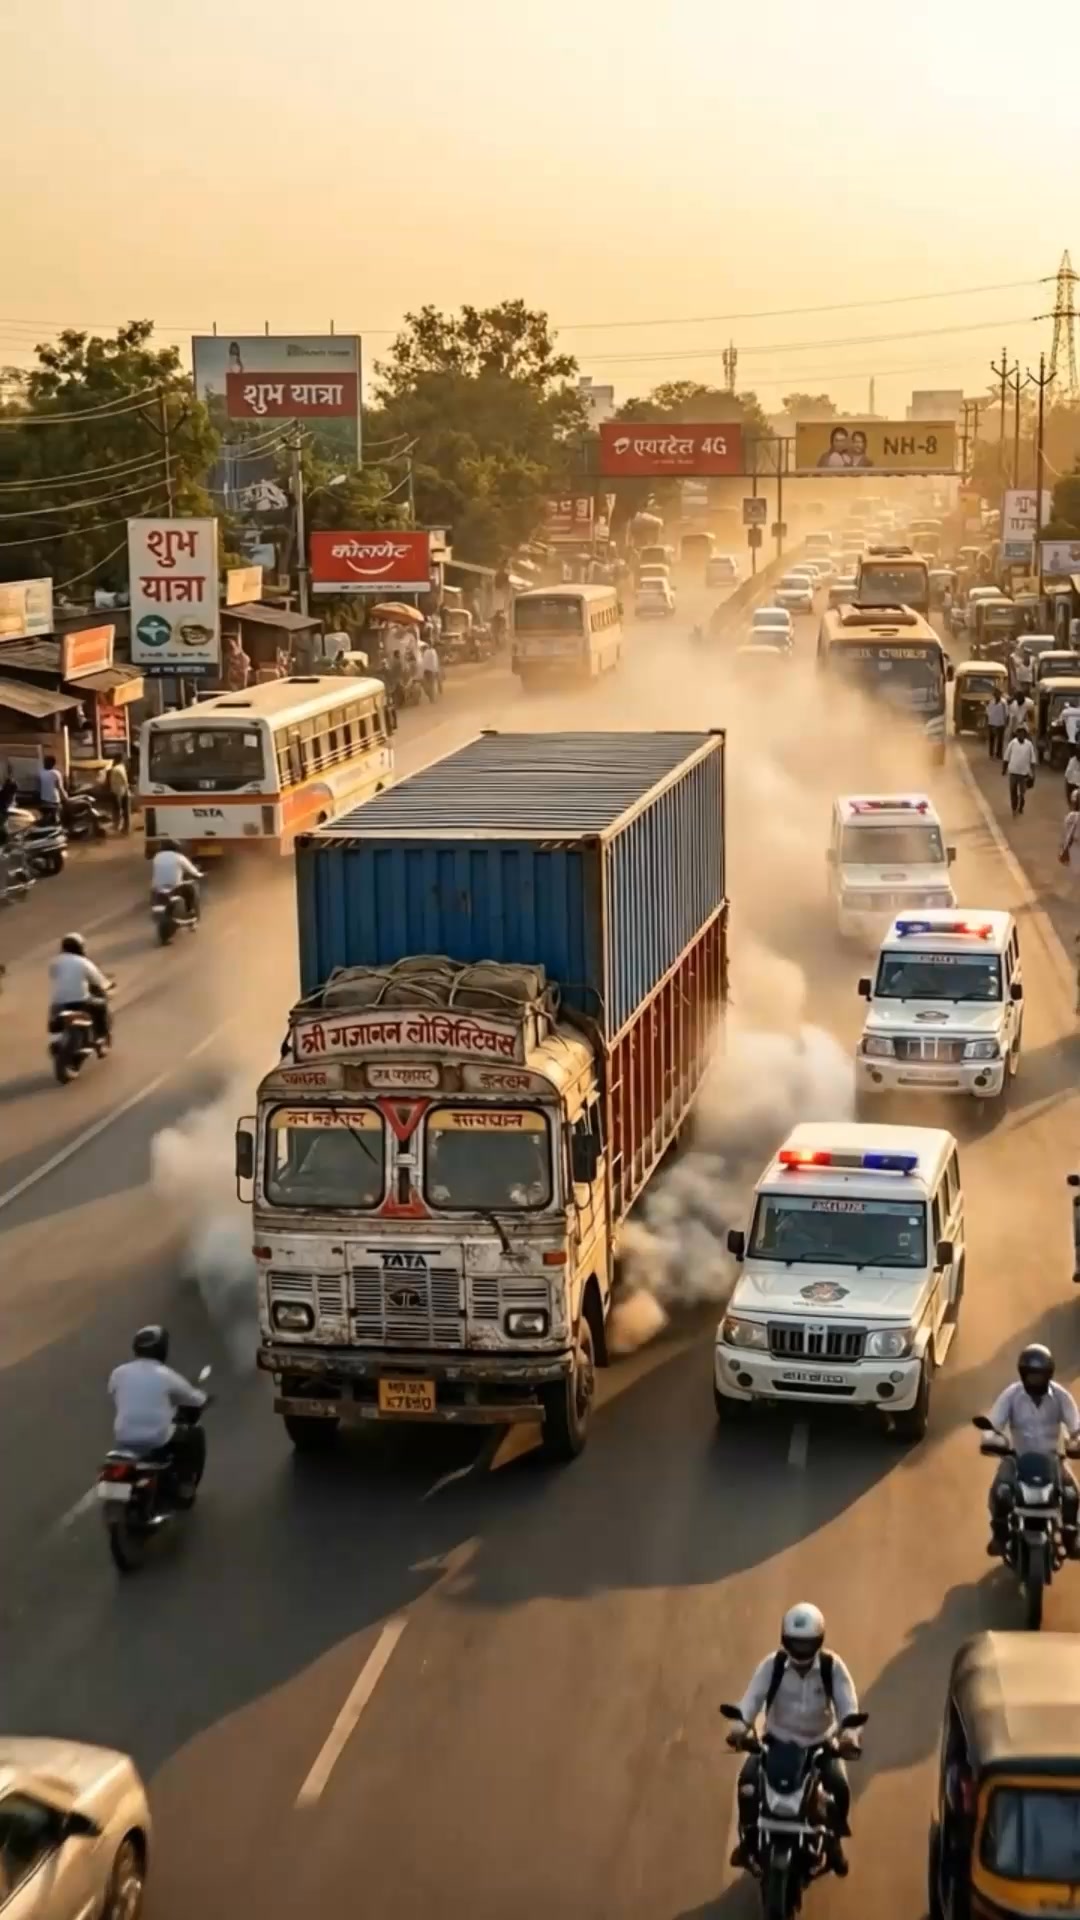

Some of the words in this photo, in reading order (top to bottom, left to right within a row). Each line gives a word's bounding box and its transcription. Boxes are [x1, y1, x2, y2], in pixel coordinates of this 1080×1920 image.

[243, 383, 284, 415] शुभ
[290, 383, 344, 405] यात्रा
[633, 434, 695, 457] एयरटेल
[701, 436, 728, 455] 4G
[882, 435, 938, 456] NH-8
[147, 529, 199, 569] शुभ
[330, 538, 413, 559] कोलगेट
[138, 575, 207, 603] यात्रा
[327, 1021, 403, 1048] गजानन
[381, 1254, 427, 1268] TATA
